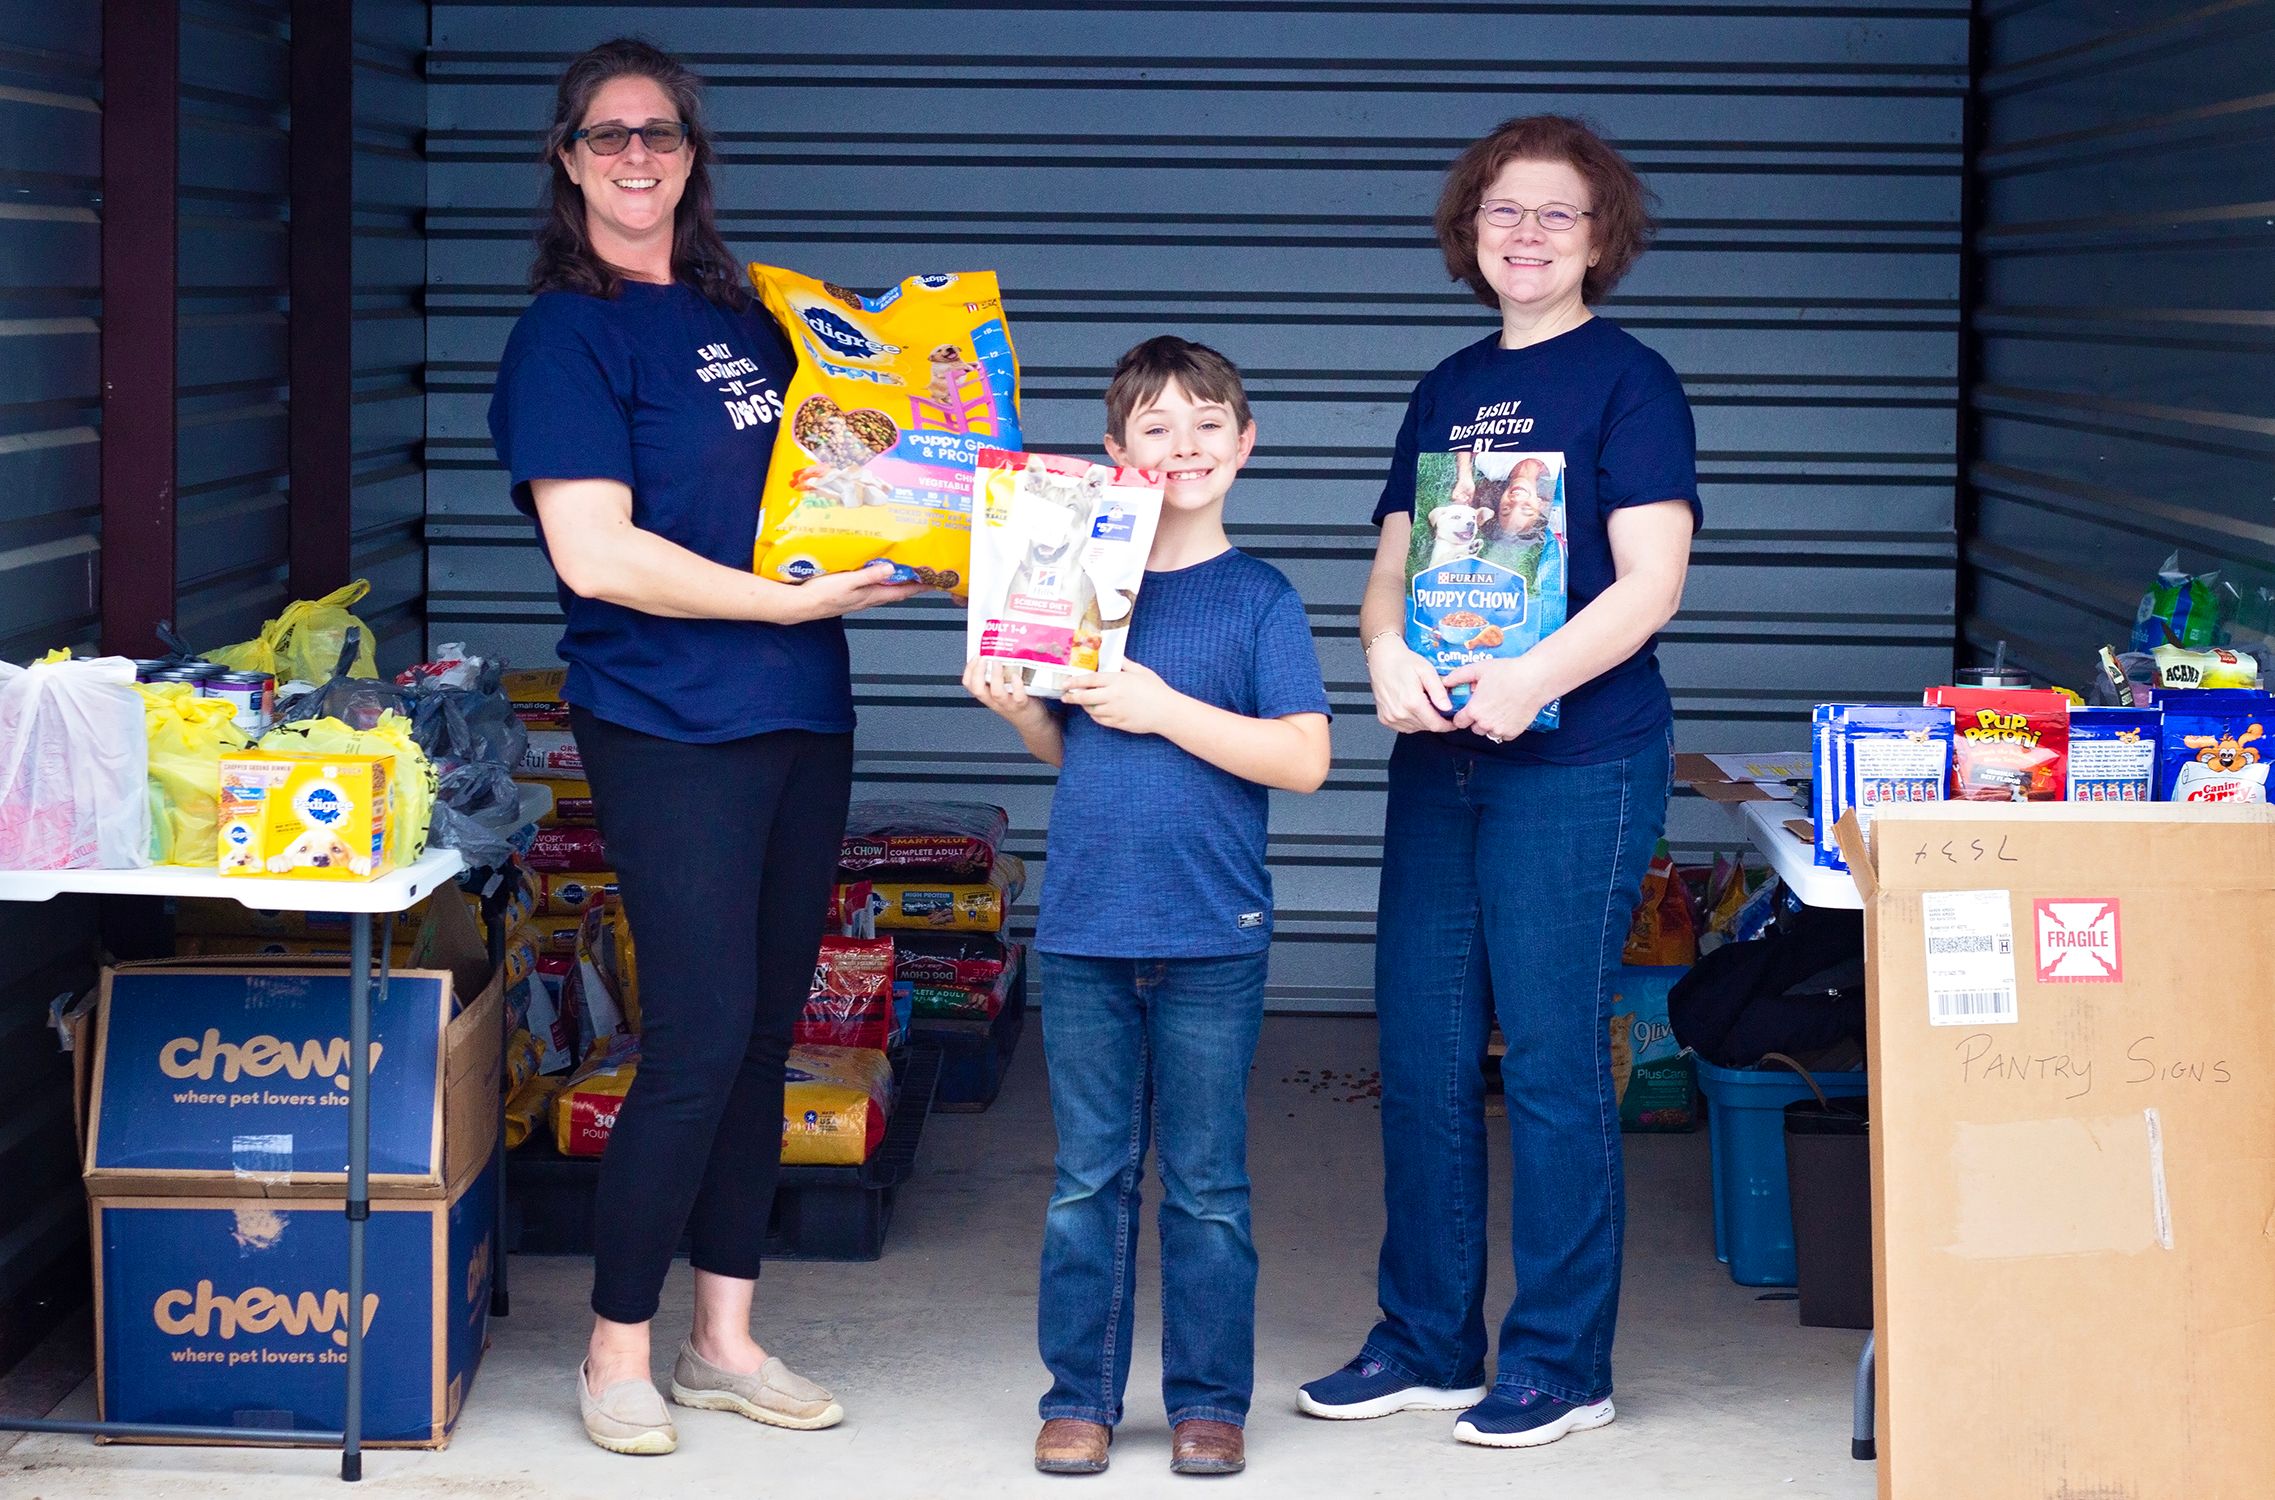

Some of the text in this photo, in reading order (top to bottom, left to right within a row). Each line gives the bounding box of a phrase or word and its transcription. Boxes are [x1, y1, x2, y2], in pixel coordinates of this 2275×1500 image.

[795, 308, 902, 354] edigree
[1475, 401, 1521, 421] EASILY
[1449, 418, 1534, 441] DISTRACTED
[1472, 438, 1494, 452] BY
[1450, 573, 1494, 583] PURINA
[1417, 589, 1520, 609] PUPPY CHOW
[1437, 650, 1494, 664] Complete
[2166, 664, 2200, 684] ACANA
[1964, 727, 2042, 748] Peroni
[853, 845, 883, 856] CHOW
[889, 848, 965, 857] COMPLETE ADULT
[2000, 941, 2009, 952] H
[2047, 930, 2109, 948] FRAGILE
[901, 970, 954, 980] DOG CHOW
[936, 988, 965, 998] ADULT
[1634, 1021, 1673, 1054] 9Liv
[1637, 1069, 1689, 1079] PlusCare
[1955, 1033, 2231, 1100] PANTRY SIGNS
[173, 1089, 349, 1109] where pet lovers sho
[171, 1348, 348, 1367] where pet lovers sho
